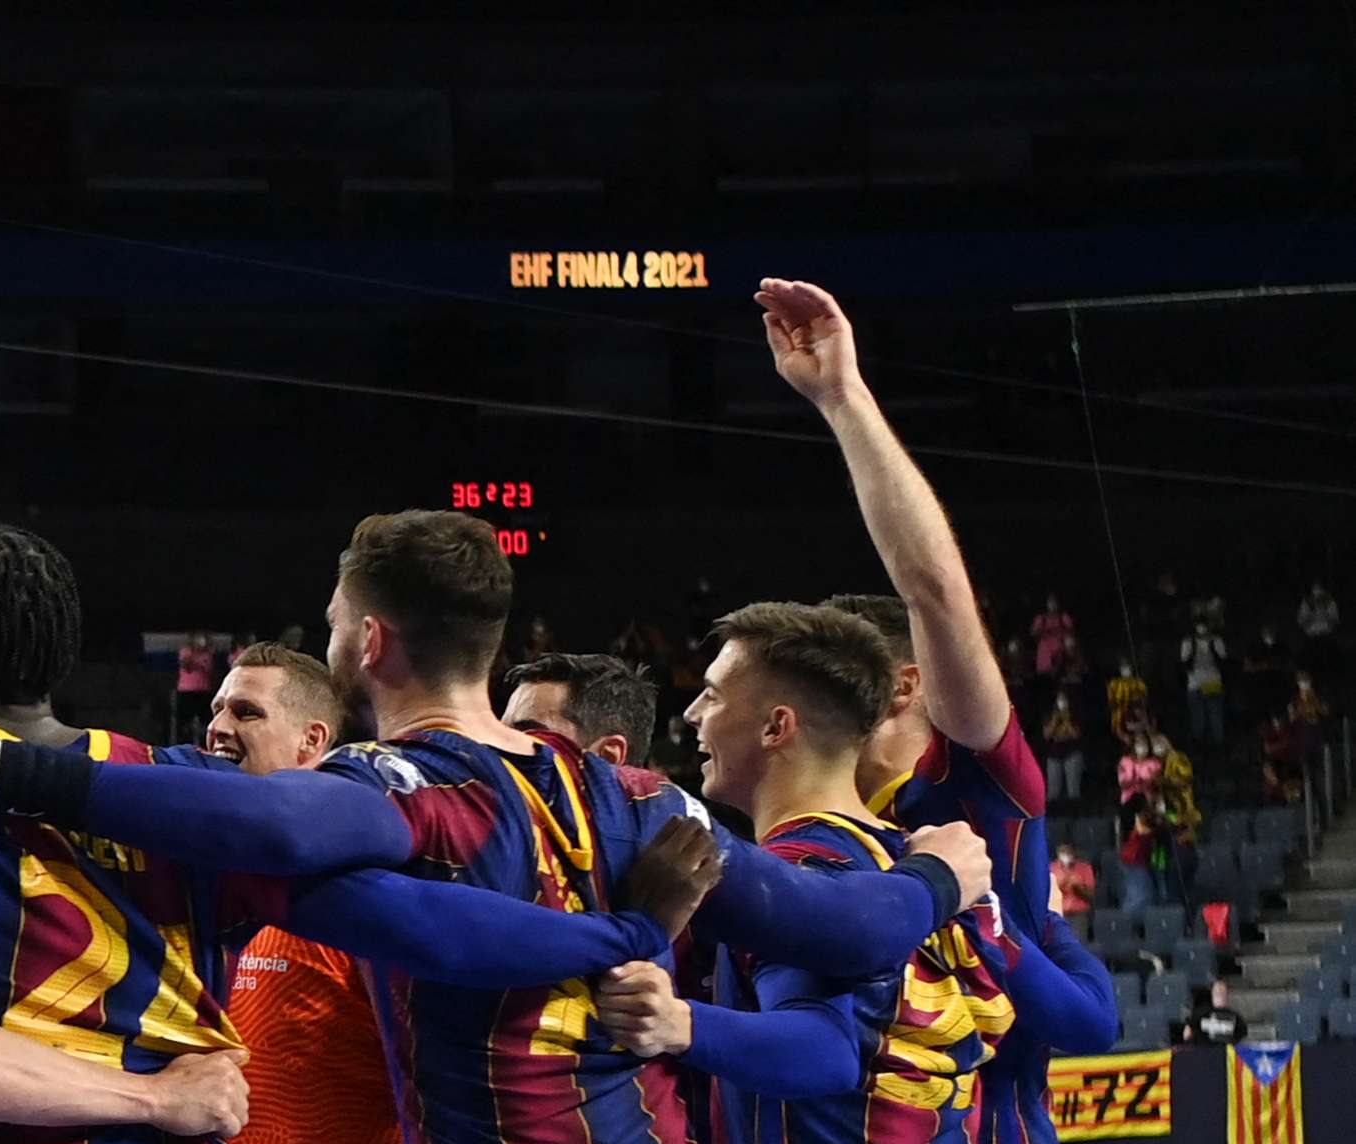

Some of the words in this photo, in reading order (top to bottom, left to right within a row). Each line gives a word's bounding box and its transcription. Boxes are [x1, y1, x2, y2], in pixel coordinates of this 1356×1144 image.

[511, 252, 553, 288] EHF
[557, 251, 640, 288] FINAL4
[643, 251, 709, 288] 2021
[452, 482, 481, 508] 36
[502, 482, 532, 508] 23
